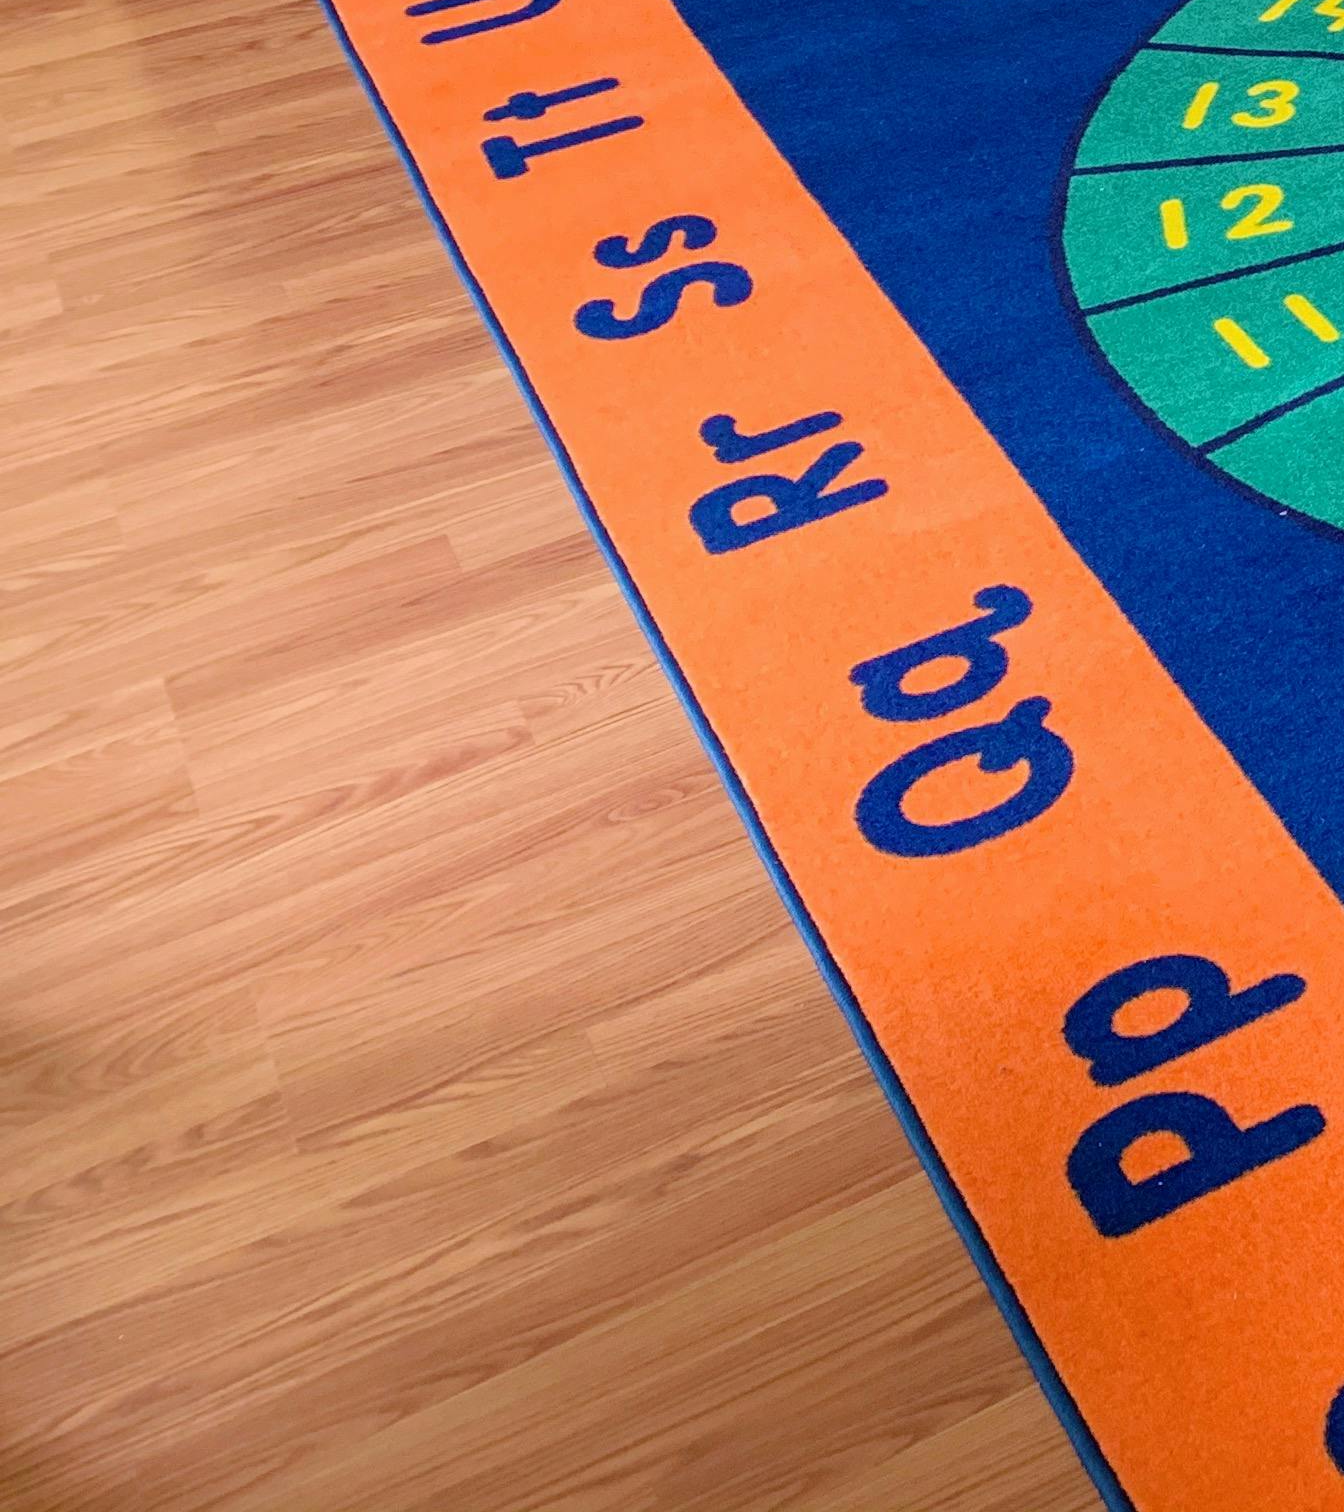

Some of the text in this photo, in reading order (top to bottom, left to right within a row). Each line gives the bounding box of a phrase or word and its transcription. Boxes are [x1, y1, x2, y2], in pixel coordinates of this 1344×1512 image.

[482, 78, 644, 179] Tt
[1184, 81, 1298, 128] 13
[1161, 185, 1291, 248] 12
[574, 215, 753, 340] Ss
[1215, 295, 1338, 367] 11
[689, 412, 888, 554] Rr
[849, 584, 1073, 857] Qq
[1061, 954, 1326, 1239] Pp
